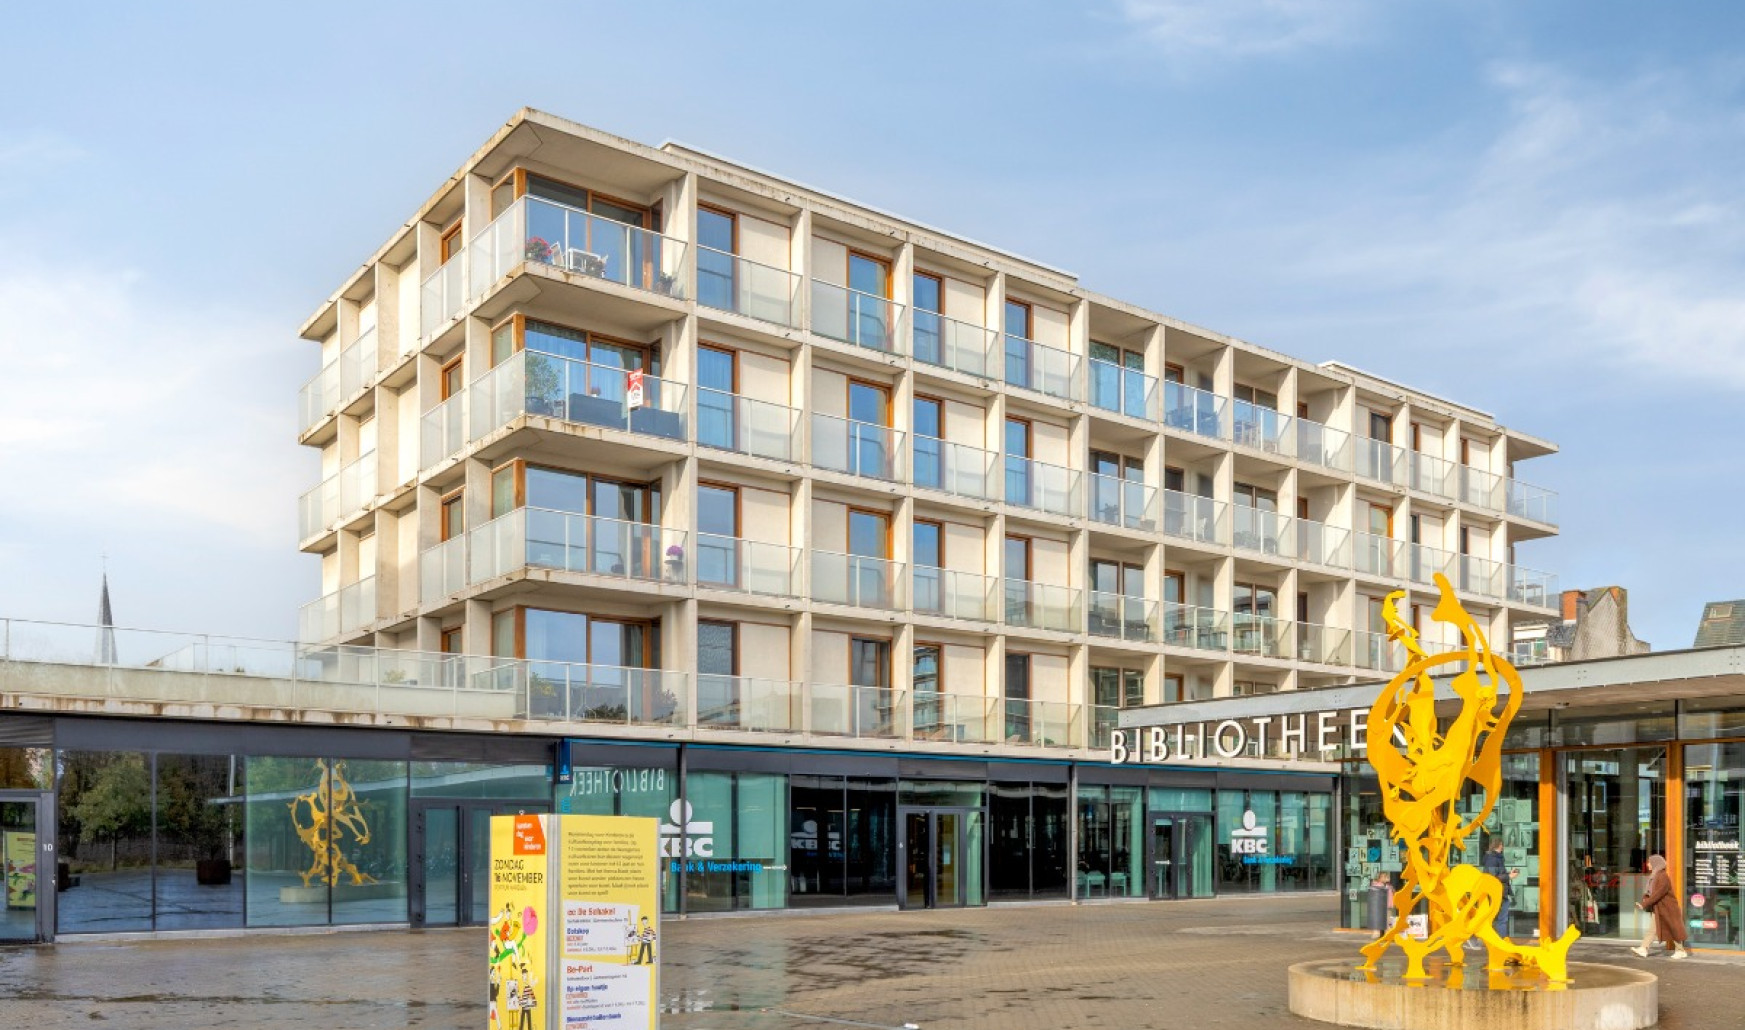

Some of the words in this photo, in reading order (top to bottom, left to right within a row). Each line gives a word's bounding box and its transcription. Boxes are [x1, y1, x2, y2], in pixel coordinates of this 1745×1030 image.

[1111, 708, 1408, 764] BIBLIOTHEE
[43, 843, 53, 852] 10
[1231, 838, 1268, 854] KBC
[494, 859, 524, 870] ZONDAG
[697, 861, 705, 872] &
[707, 860, 763, 874] Verzekering
[502, 872, 543, 884] NOVEMBER
